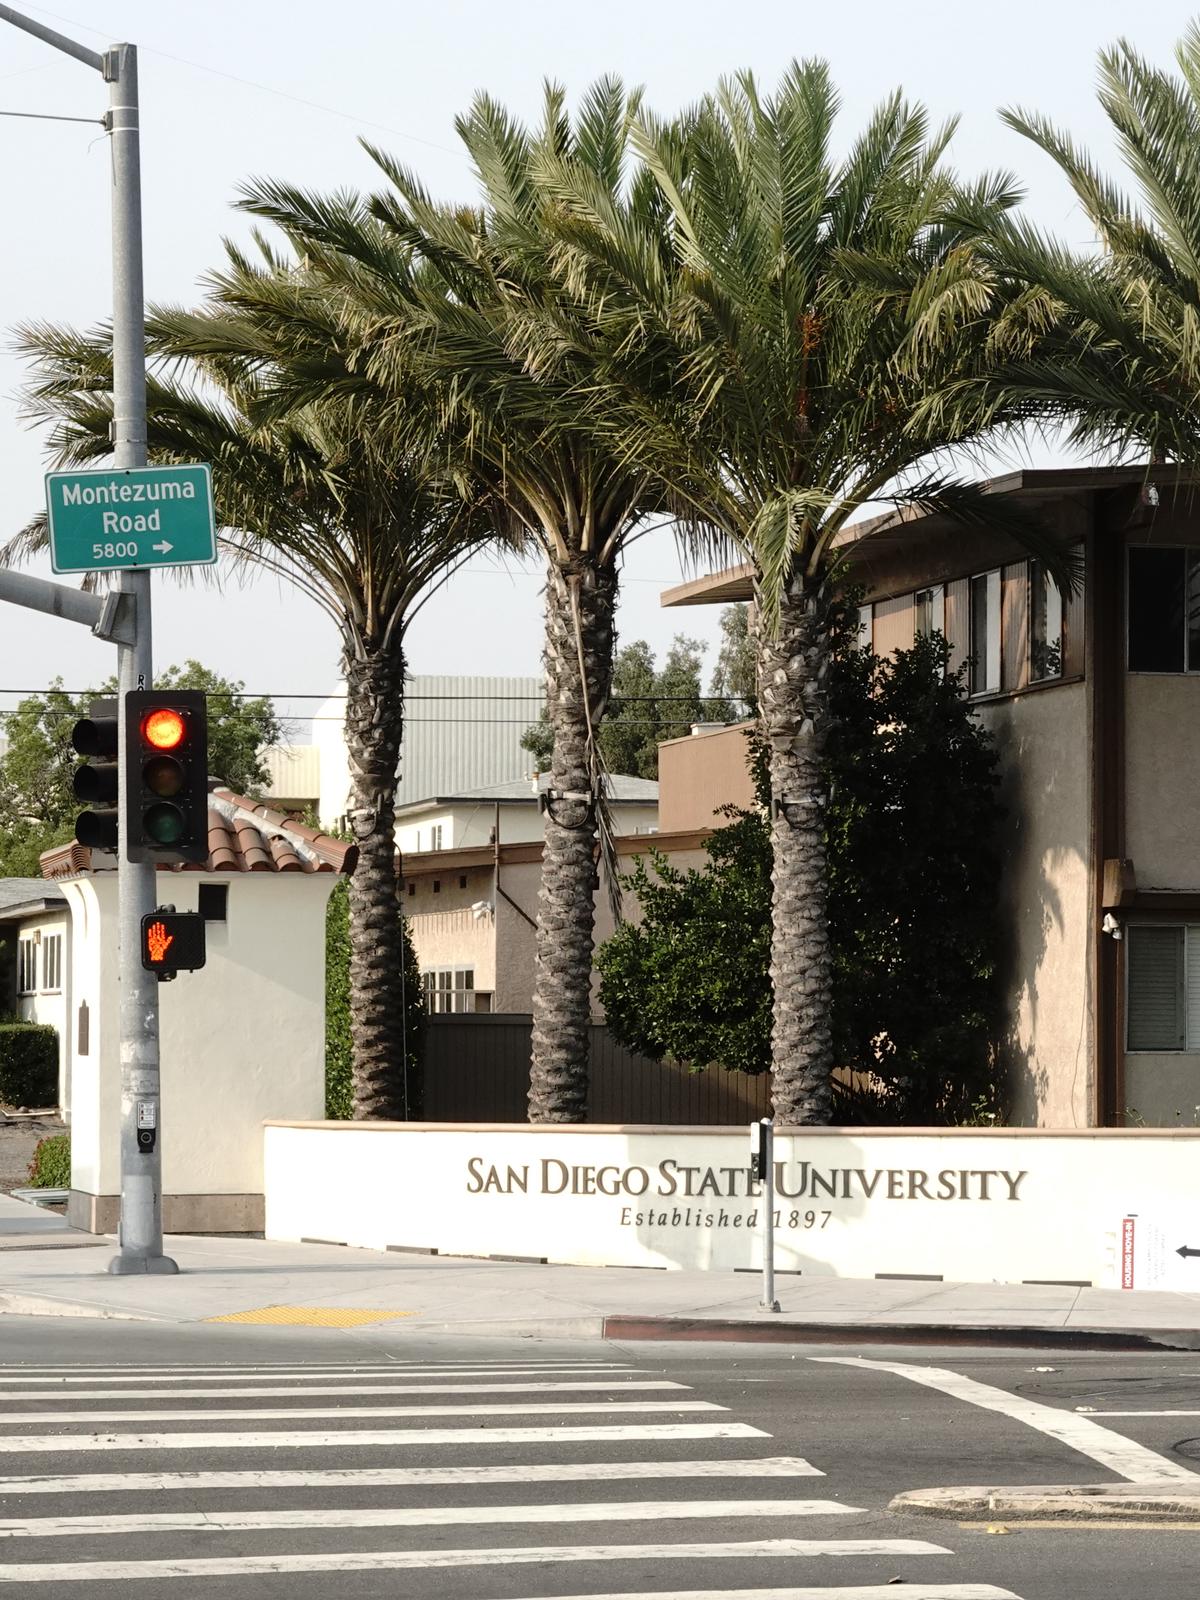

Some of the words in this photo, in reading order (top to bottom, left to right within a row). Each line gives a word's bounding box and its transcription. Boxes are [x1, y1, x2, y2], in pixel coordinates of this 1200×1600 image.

[62, 481, 195, 506] Montezuma
[103, 509, 161, 534] Road
[92, 541, 138, 559] 5800
[466, 1157, 530, 1193] SAN
[540, 1158, 650, 1195] DIEGO
[657, 1159, 763, 1197] STATE
[773, 1161, 1028, 1201] UNIVERSITY
[620, 1207, 759, 1228] Established
[773, 1210, 833, 1229] 1897
[1124, 1221, 1133, 1253] MOVE-IN
[1124, 1254, 1133, 1288] HOUSING
